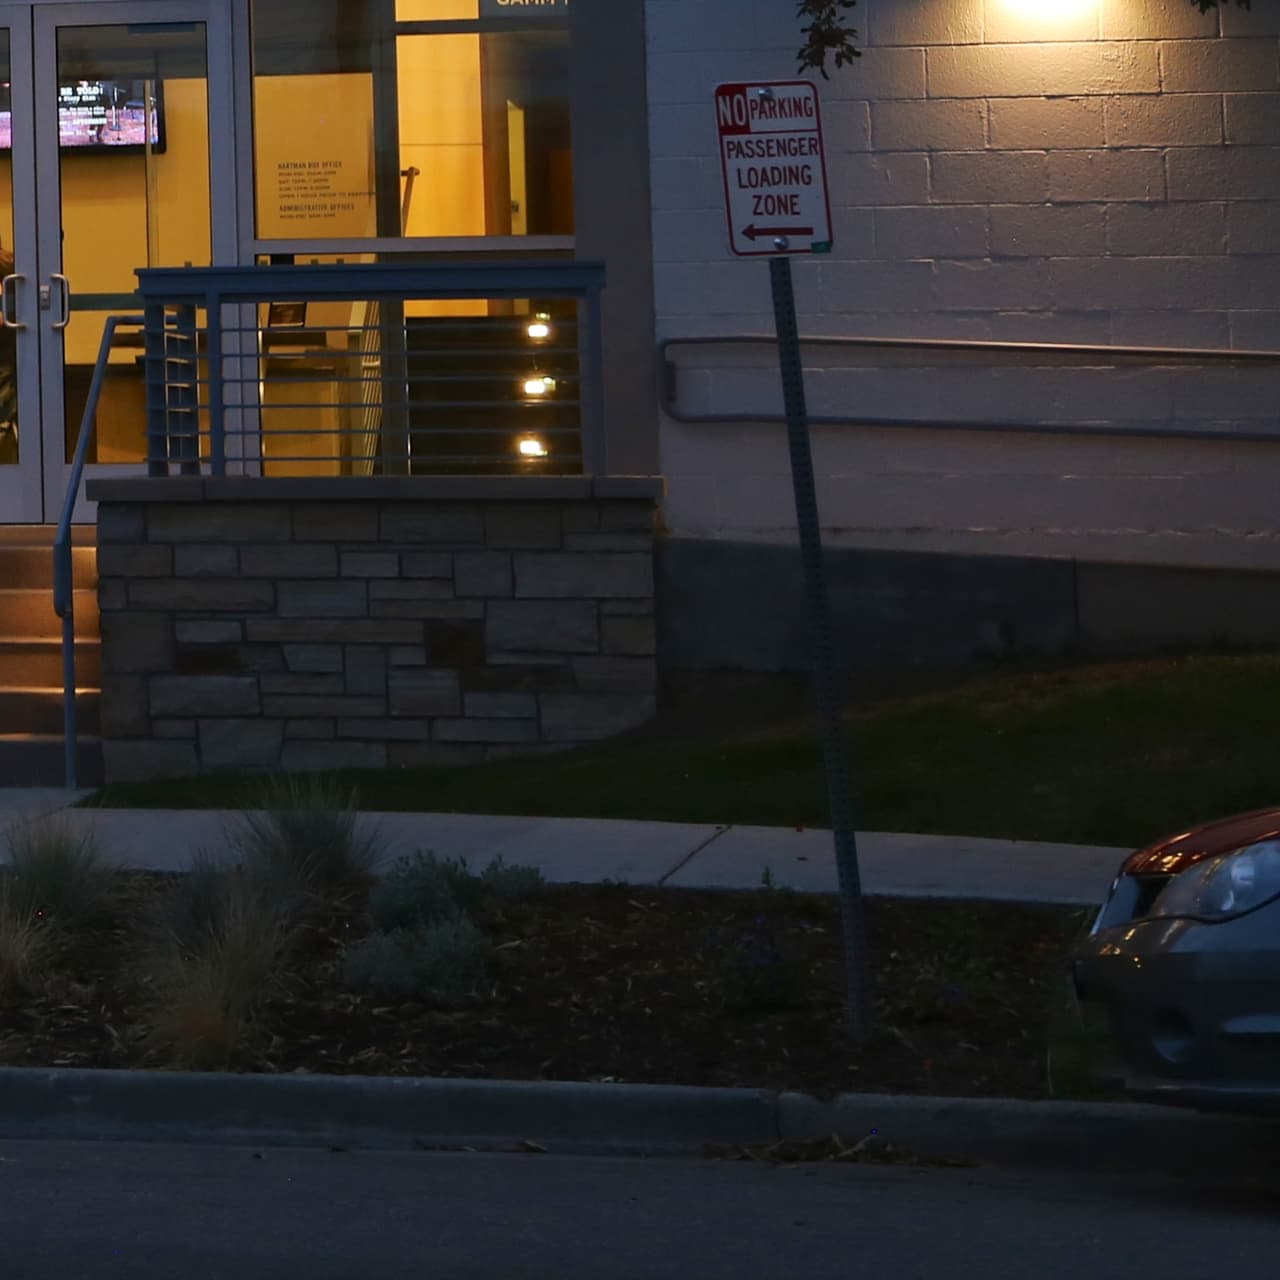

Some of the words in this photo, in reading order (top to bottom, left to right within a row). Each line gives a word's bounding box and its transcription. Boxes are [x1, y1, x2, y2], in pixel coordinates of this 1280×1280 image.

[718, 94, 746, 126] NO
[750, 96, 813, 120] PARKING
[726, 137, 819, 159] PASSENGER
[737, 164, 812, 189] LOADING
[752, 194, 800, 215] ZONE
